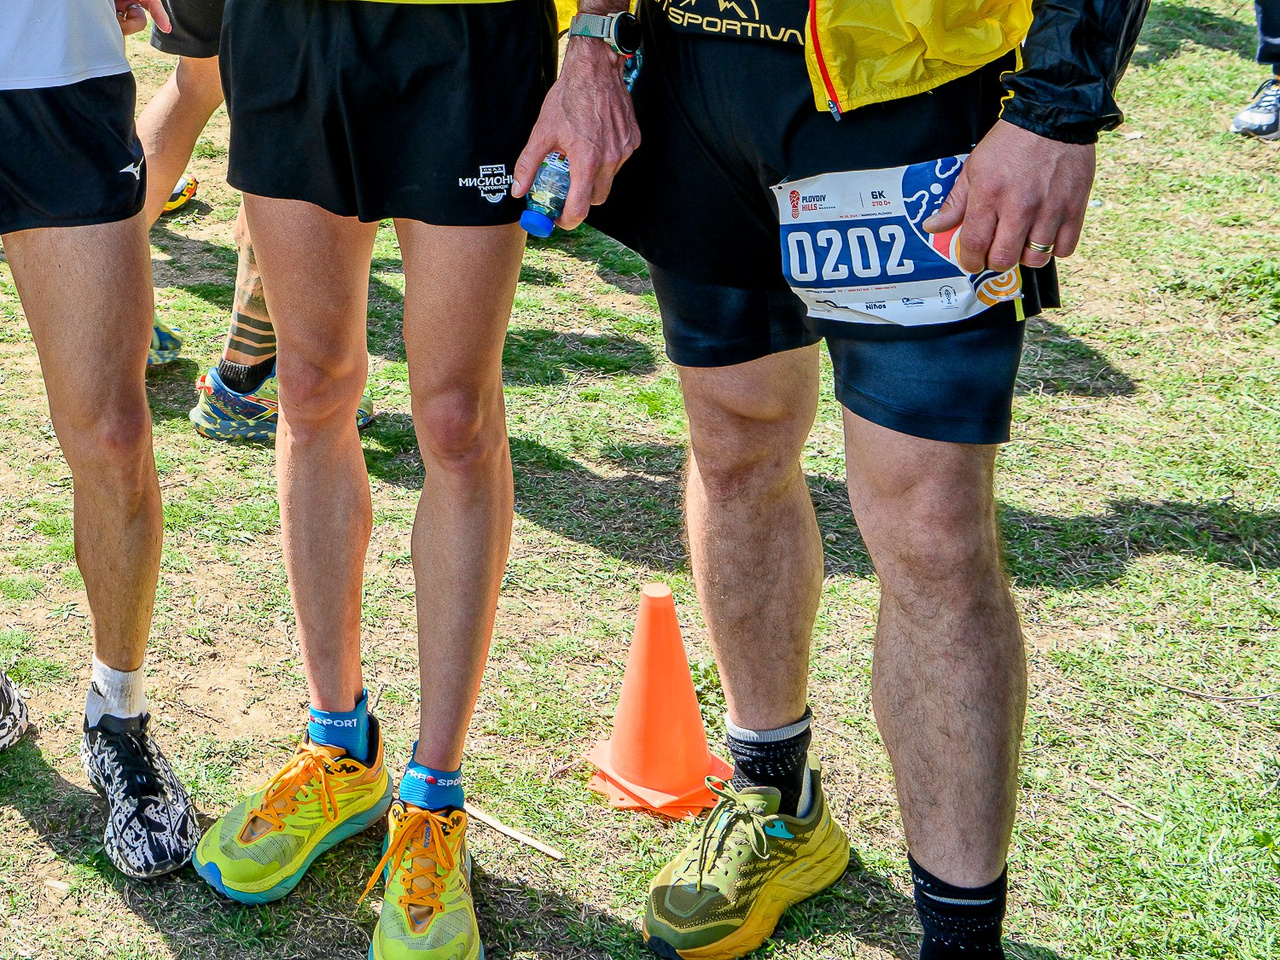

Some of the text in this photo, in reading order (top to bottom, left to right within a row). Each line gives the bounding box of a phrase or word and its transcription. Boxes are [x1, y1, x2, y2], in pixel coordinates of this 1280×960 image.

[668, 6, 805, 46] SPORTIVA
[802, 190, 886, 203] PLOVDIV 6K
[802, 203, 818, 212] HILLS
[787, 224, 914, 282] 0202
